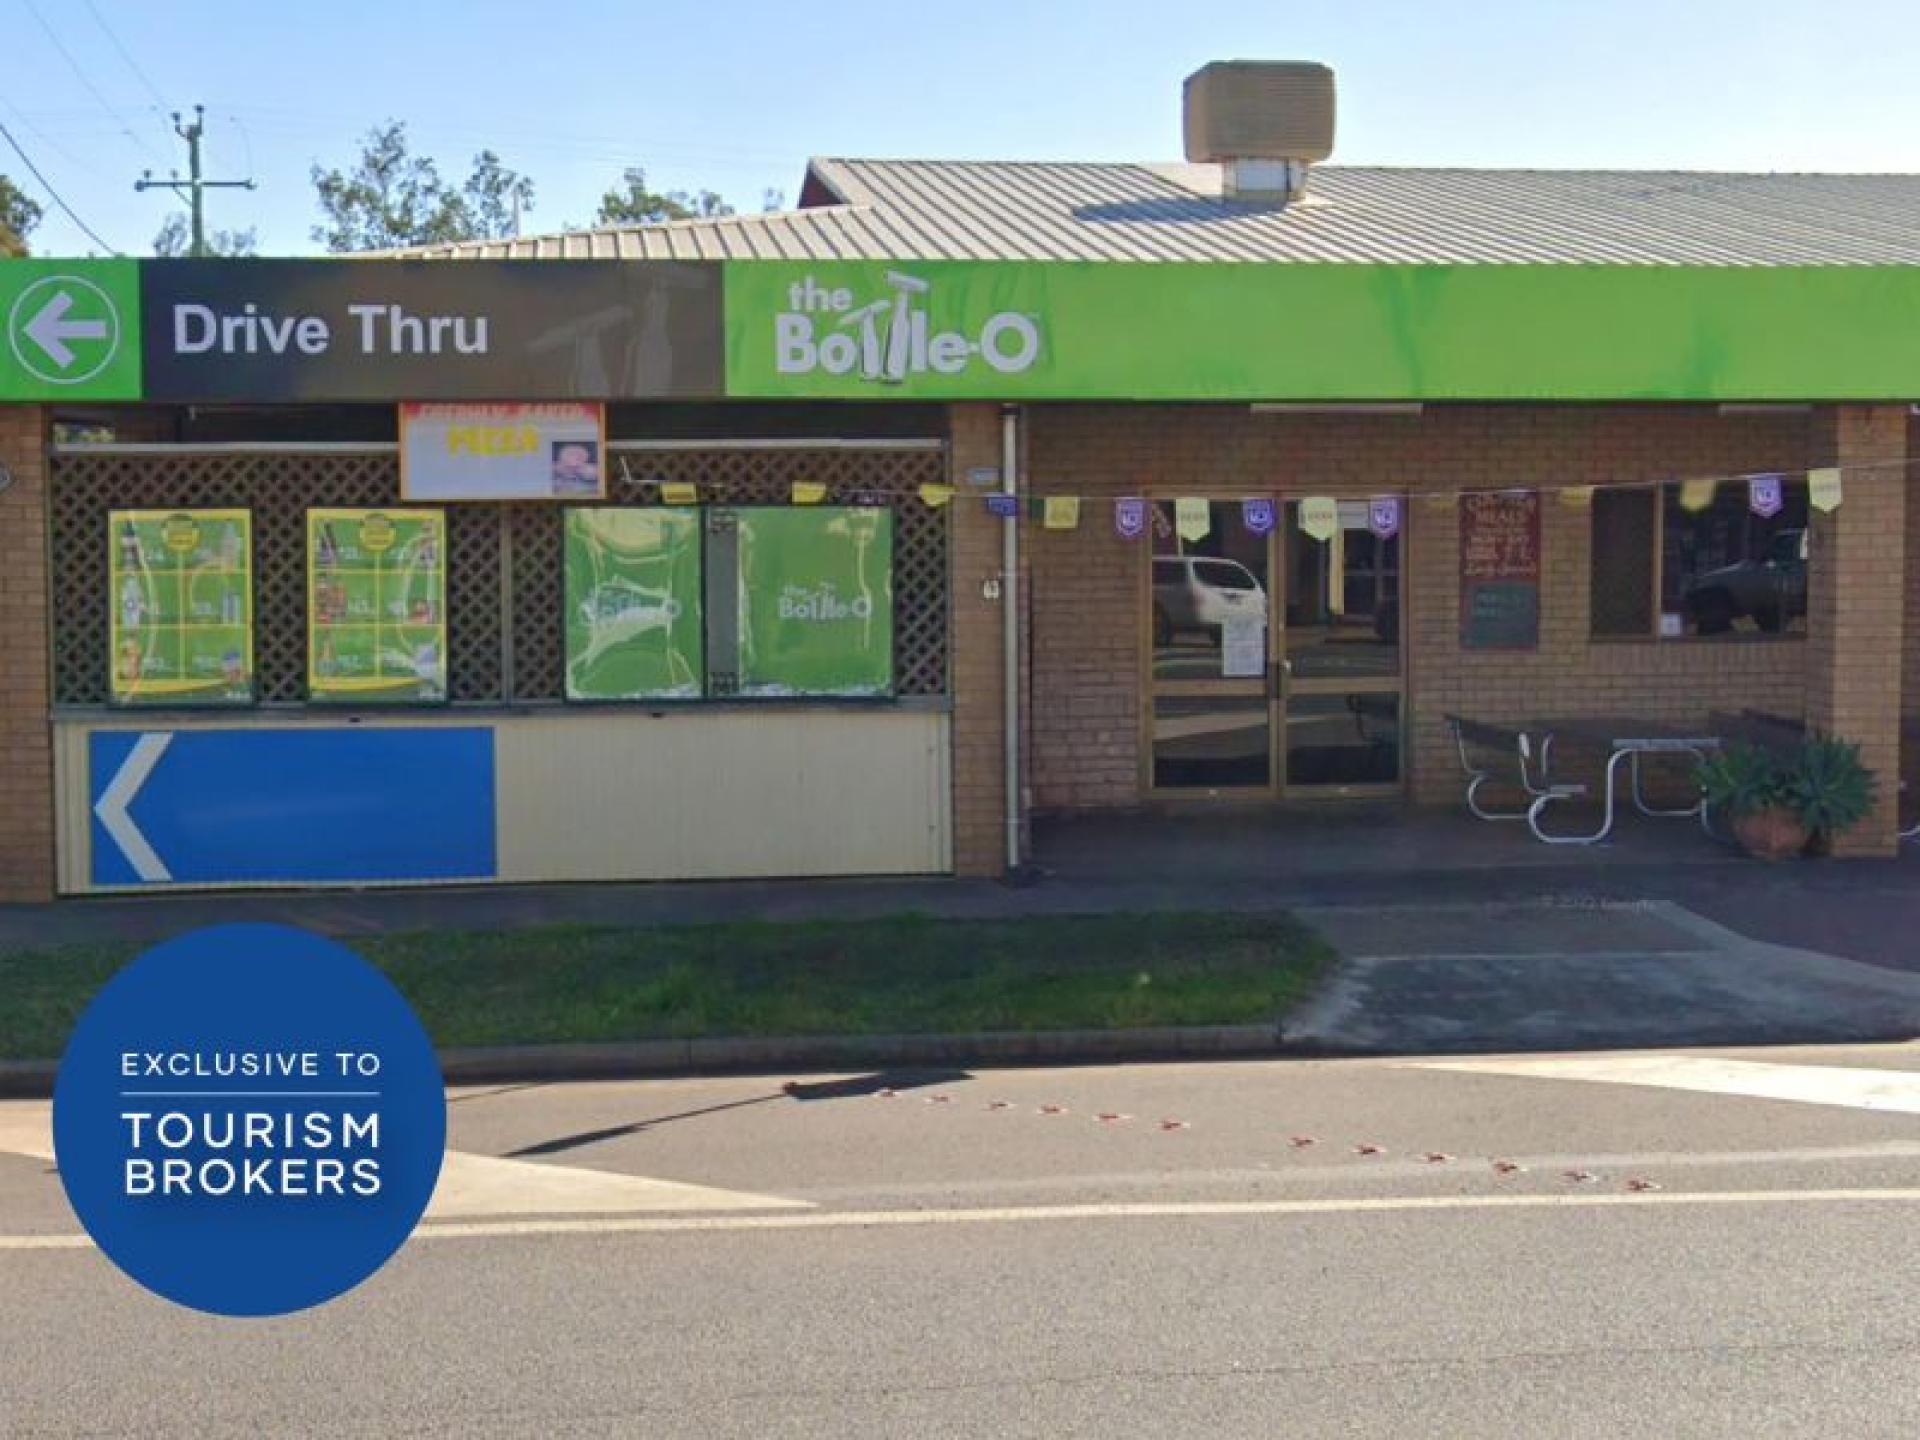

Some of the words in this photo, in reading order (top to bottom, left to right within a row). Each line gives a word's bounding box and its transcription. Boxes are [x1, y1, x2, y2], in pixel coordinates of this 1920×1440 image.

[790, 276, 852, 312] the
[174, 303, 330, 354] Drive
[348, 304, 489, 354] Thru
